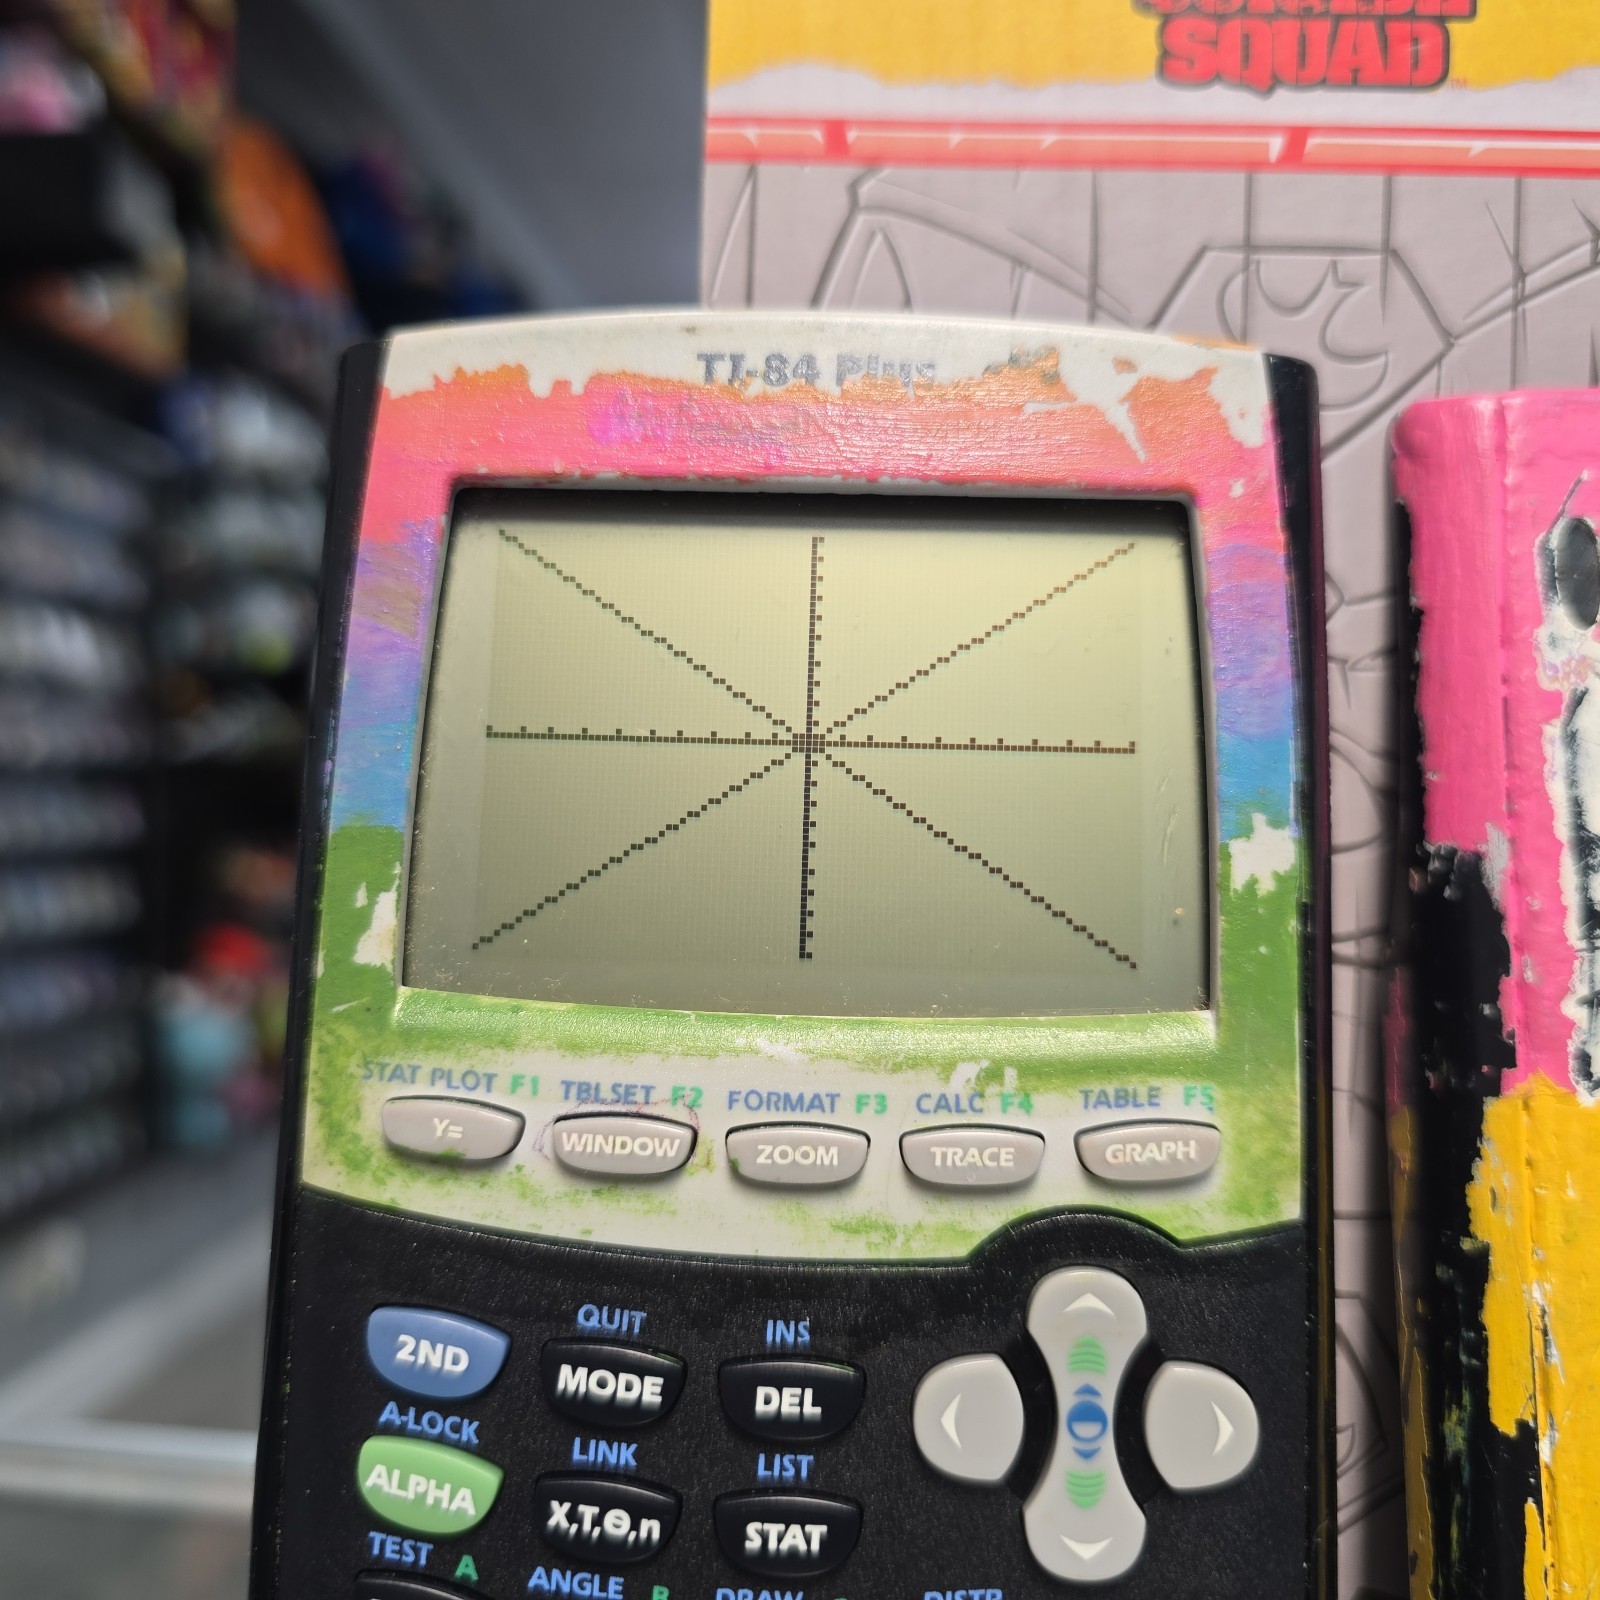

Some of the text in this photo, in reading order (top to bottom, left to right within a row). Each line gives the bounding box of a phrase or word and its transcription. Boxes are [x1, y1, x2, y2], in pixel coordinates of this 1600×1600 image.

[1161, 15, 1449, 95] SQUAD
[363, 1060, 498, 1093] STAT PLOT
[510, 1074, 540, 1096] F1
[561, 1080, 656, 1105] TBLSET
[672, 1086, 704, 1108] F2
[728, 1090, 840, 1114] FORMAT
[855, 1093, 888, 1114] F3
[916, 1093, 983, 1114] CALC
[1001, 1093, 1033, 1115] F4
[1078, 1086, 1161, 1110] TABLE
[1184, 1085, 1214, 1112] F5
[433, 1117, 463, 1139] Y=
[562, 1132, 680, 1158] WINDOW
[756, 1144, 839, 1167] ZOOM
[930, 1146, 1015, 1168] TRACE
[1105, 1140, 1196, 1165] GRAPH
[578, 1303, 647, 1334] QUIT
[766, 1319, 810, 1345] INS
[396, 1334, 469, 1374] 2ND
[557, 1364, 664, 1403] MODE
[755, 1386, 822, 1416] DEL
[378, 1400, 479, 1444] A-LOCK
[573, 1437, 638, 1467] LINK
[757, 1453, 814, 1480] LIST
[365, 1464, 478, 1516] ALPHA
[368, 1531, 433, 1566] TEST
[745, 1522, 828, 1554] STAT
[454, 1555, 479, 1581] A
[528, 1566, 624, 1600] ANGLE
